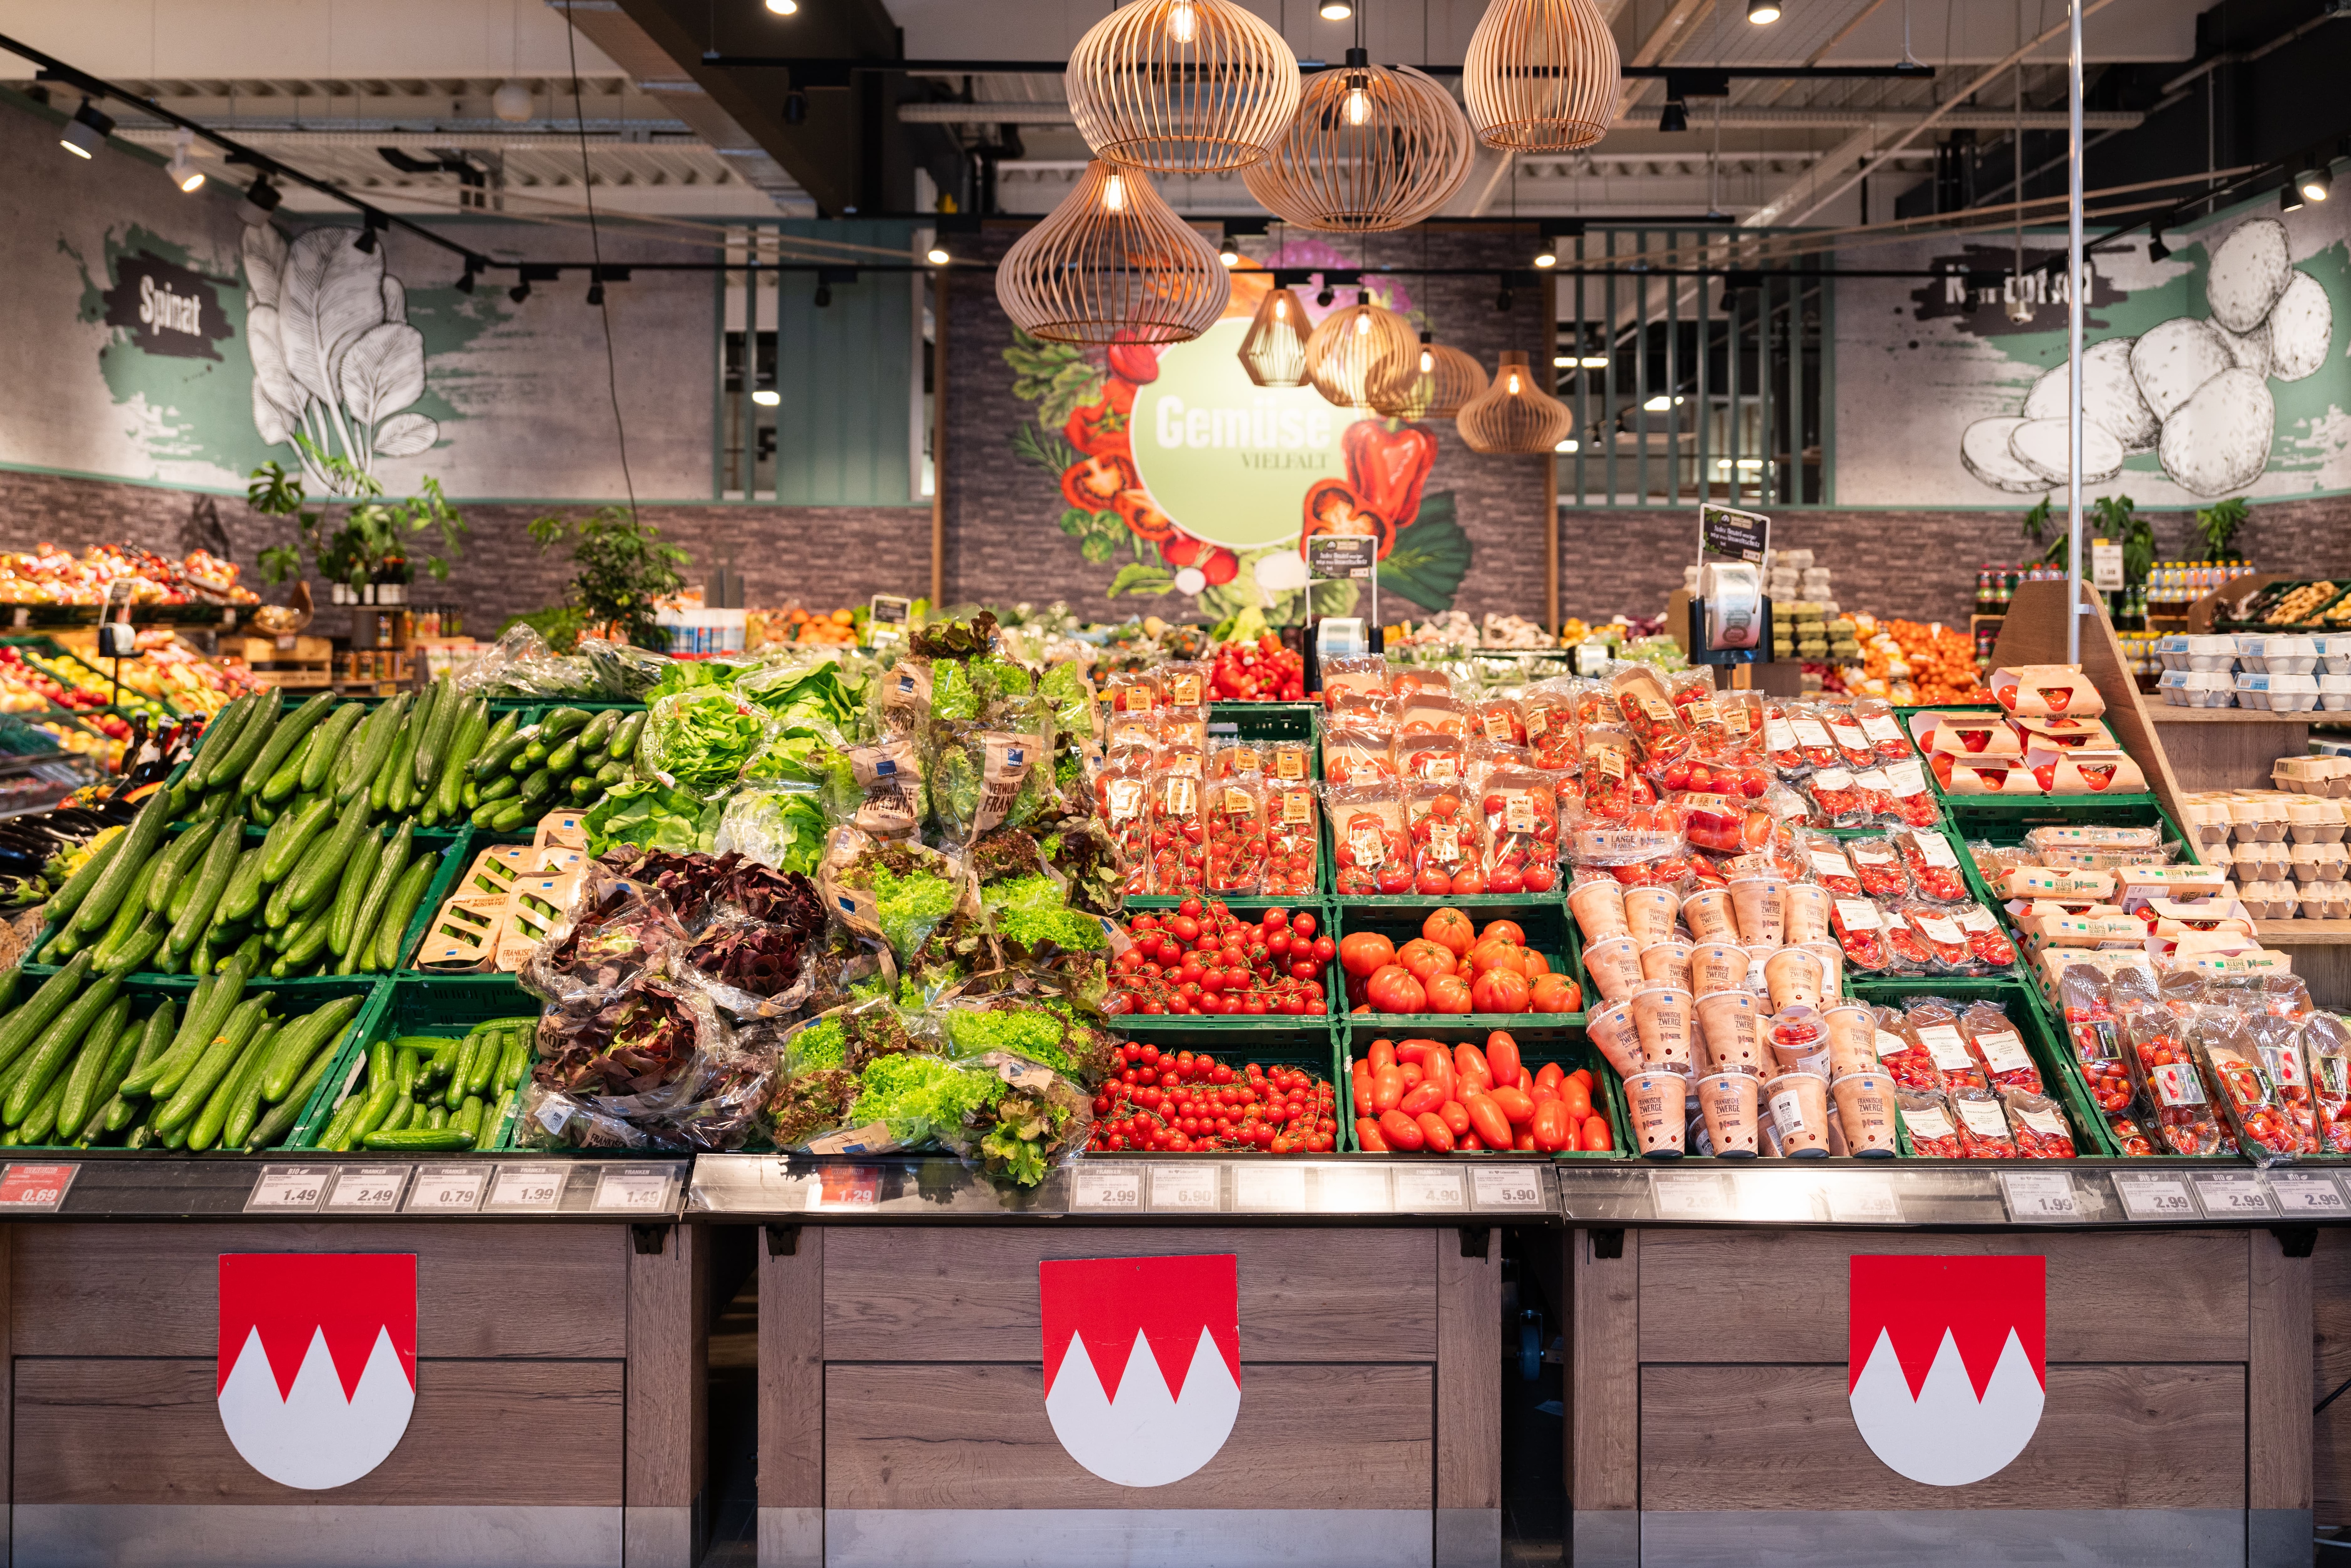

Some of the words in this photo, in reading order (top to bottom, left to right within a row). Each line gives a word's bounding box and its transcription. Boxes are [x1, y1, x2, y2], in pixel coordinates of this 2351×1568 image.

[140, 275, 201, 337] Spinat
[1156, 395, 1330, 448] Gemüse
[1240, 452, 1329, 469] VIELFALT
[990, 781, 1021, 796] VERWURZ
[983, 796, 1016, 812] FRAN
[1649, 914, 1669, 924] ZWERGE
[1701, 915, 1723, 925] ZWERGE
[1806, 910, 1824, 919] ZWERGE
[1670, 970, 1689, 980] ZWERGE
[1791, 972, 1812, 981] ZWERGE
[1658, 1018, 1681, 1026] ZWERGE
[1853, 1034, 1872, 1045] ZWERGE
[1986, 1038, 2017, 1047] Naschtomaten
[1638, 1097, 1661, 1106] FRÄNKISCHE
[1714, 1098, 1739, 1107] FRÄNKISCHE
[1639, 1104, 1662, 1114] ZWERGE
[1716, 1105, 1740, 1114] ZWERGE
[22, 1189, 58, 1201] 0.69
[284, 1190, 317, 1200] 1.49
[357, 1190, 393, 1201] 2.49
[440, 1191, 474, 1202] 0.79
[627, 1191, 659, 1202] 1.49
[839, 1190, 872, 1202] 1.29
[1102, 1190, 1136, 1201] 2.99
[1178, 1190, 1212, 1201] 6.90
[1426, 1190, 1459, 1201] 4.90
[1502, 1190, 1536, 1200] 5.90
[2229, 1195, 2264, 1206] 2.99
[2305, 1195, 2340, 1205] 2.99
[2038, 1198, 2073, 1210] 1.99
[2154, 1197, 2189, 1208] 2.99
